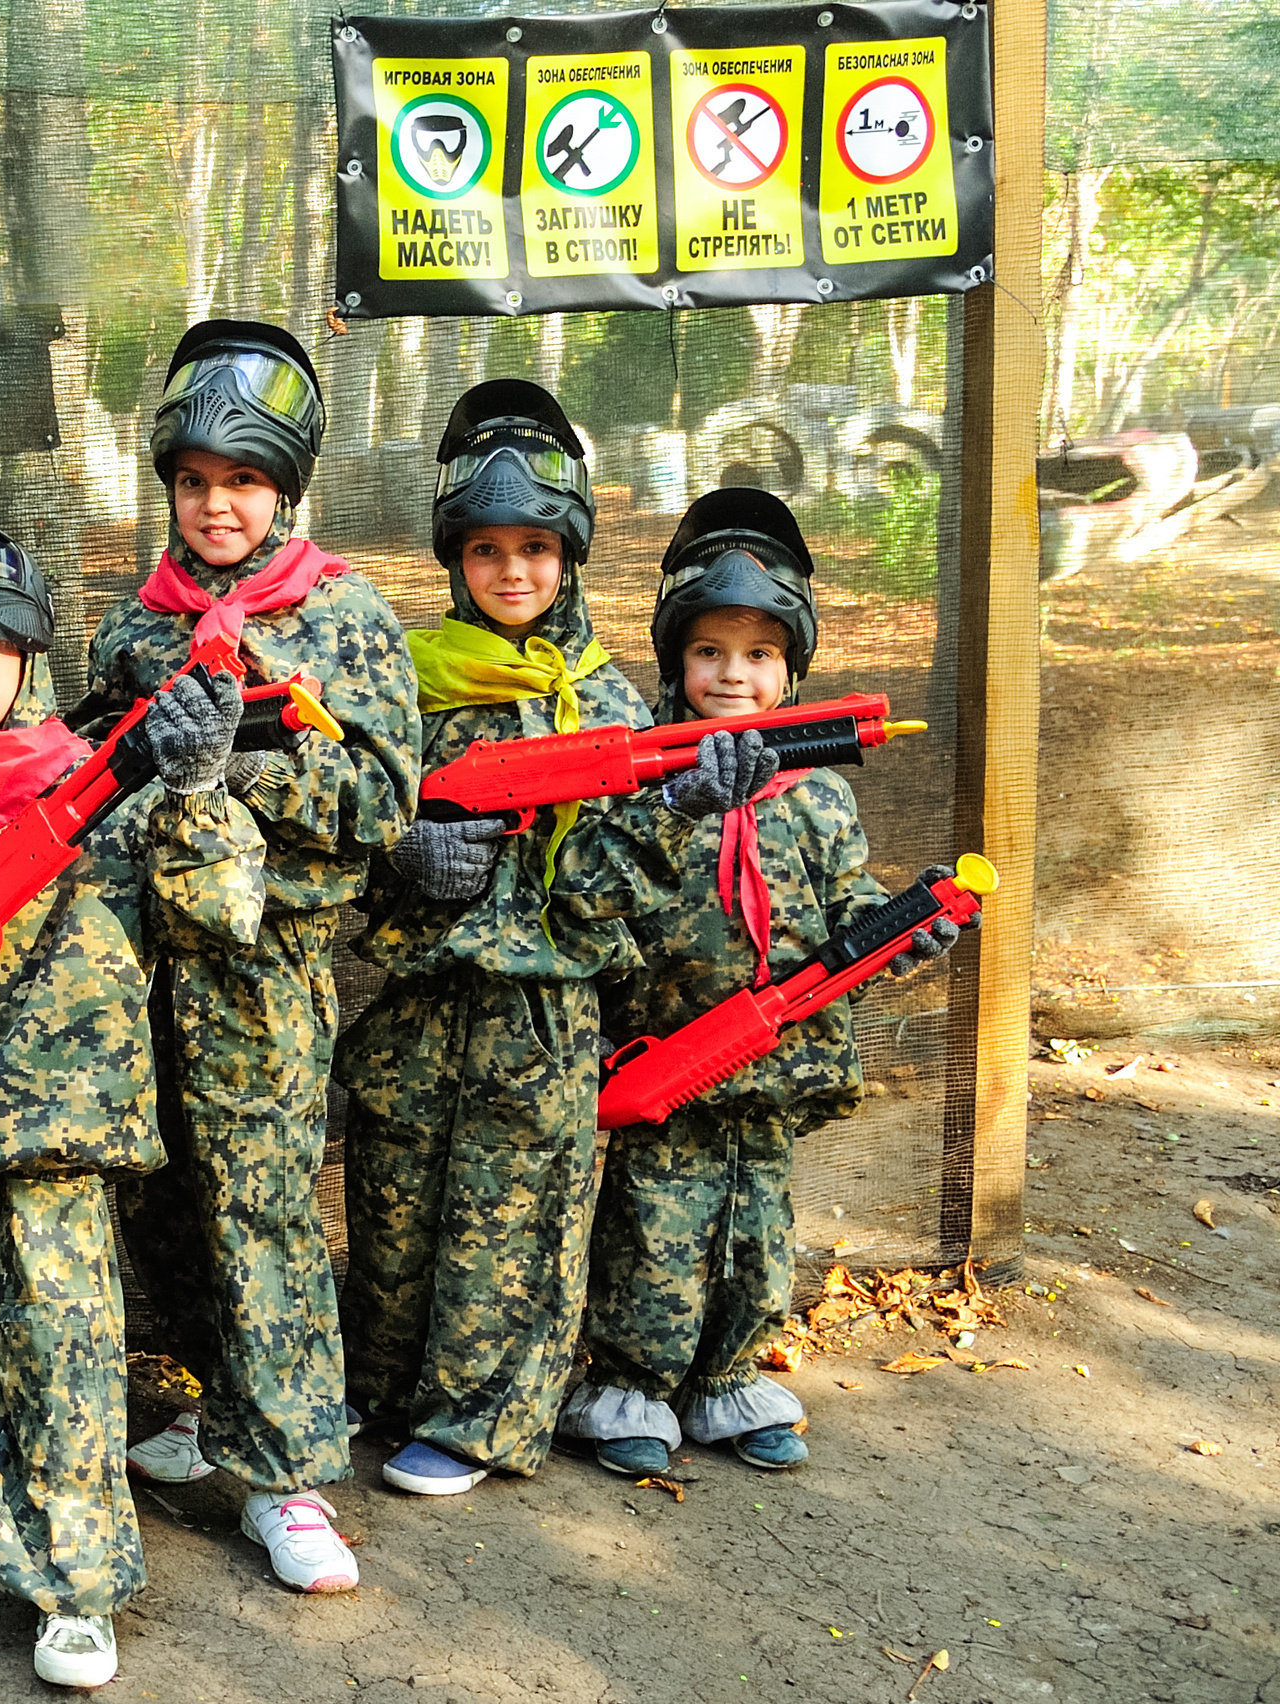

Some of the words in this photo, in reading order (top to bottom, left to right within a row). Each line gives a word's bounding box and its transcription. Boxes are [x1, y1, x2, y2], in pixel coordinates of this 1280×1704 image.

[682, 61, 709, 76] ЗОНА
[712, 58, 793, 75] ОБЕСПЕЧЕНИЯ
[838, 53, 909, 71] БЕЗОПАСНАЯ
[911, 50, 935, 67] ЗОНА
[384, 71, 452, 86] ИГРОВАЯ
[456, 71, 496, 86] ЗОНА
[537, 68, 566, 84] ЗОНА
[568, 65, 641, 82] ОБЕСПЕЧЕНИЯ
[858, 108, 872, 130] 1
[535, 204, 643, 231] ЗАГЛУШКУ
[722, 199, 757, 231] НЕ
[847, 197, 857, 219] 1
[866, 192, 928, 218] МЕТР
[391, 209, 493, 239] НАДЕТЬ
[833, 225, 863, 249] ОТ
[871, 218, 946, 246] СЕТКИ
[397, 241, 492, 267] МАСКУ!
[545, 240, 559, 264] В
[565, 238, 638, 263] СТВОЛ!
[688, 233, 792, 258] СТРЕЛЯТЬ!
